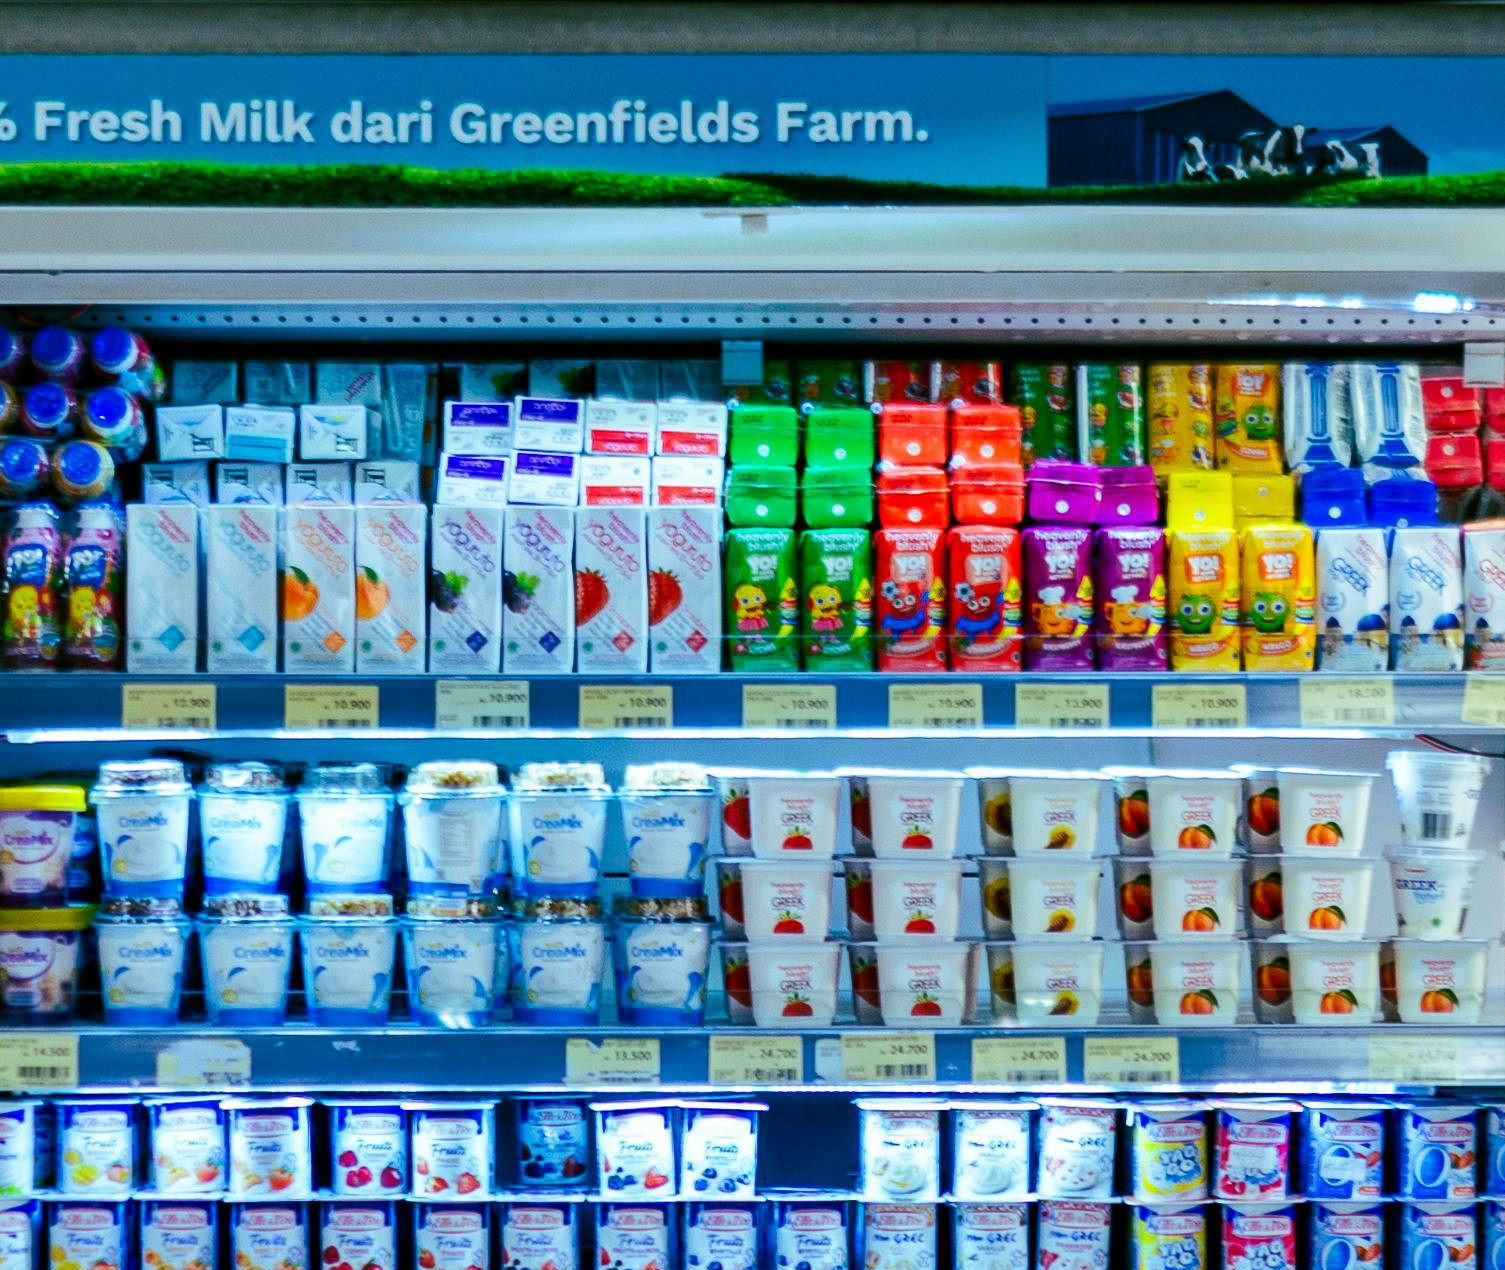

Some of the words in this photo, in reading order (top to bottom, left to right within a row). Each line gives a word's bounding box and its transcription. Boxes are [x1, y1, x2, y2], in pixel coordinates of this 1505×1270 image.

[35, 99, 181, 141] Fresh
[200, 99, 312, 142] Milk
[331, 100, 432, 143] dari
[450, 99, 759, 143] Greenfields
[777, 102, 928, 142] Farm.
[533, 814, 583, 829] CreaMix
[632, 814, 684, 829] CreaMix
[532, 944, 586, 960] CreaMix
[631, 944, 682, 959] CreaMix
